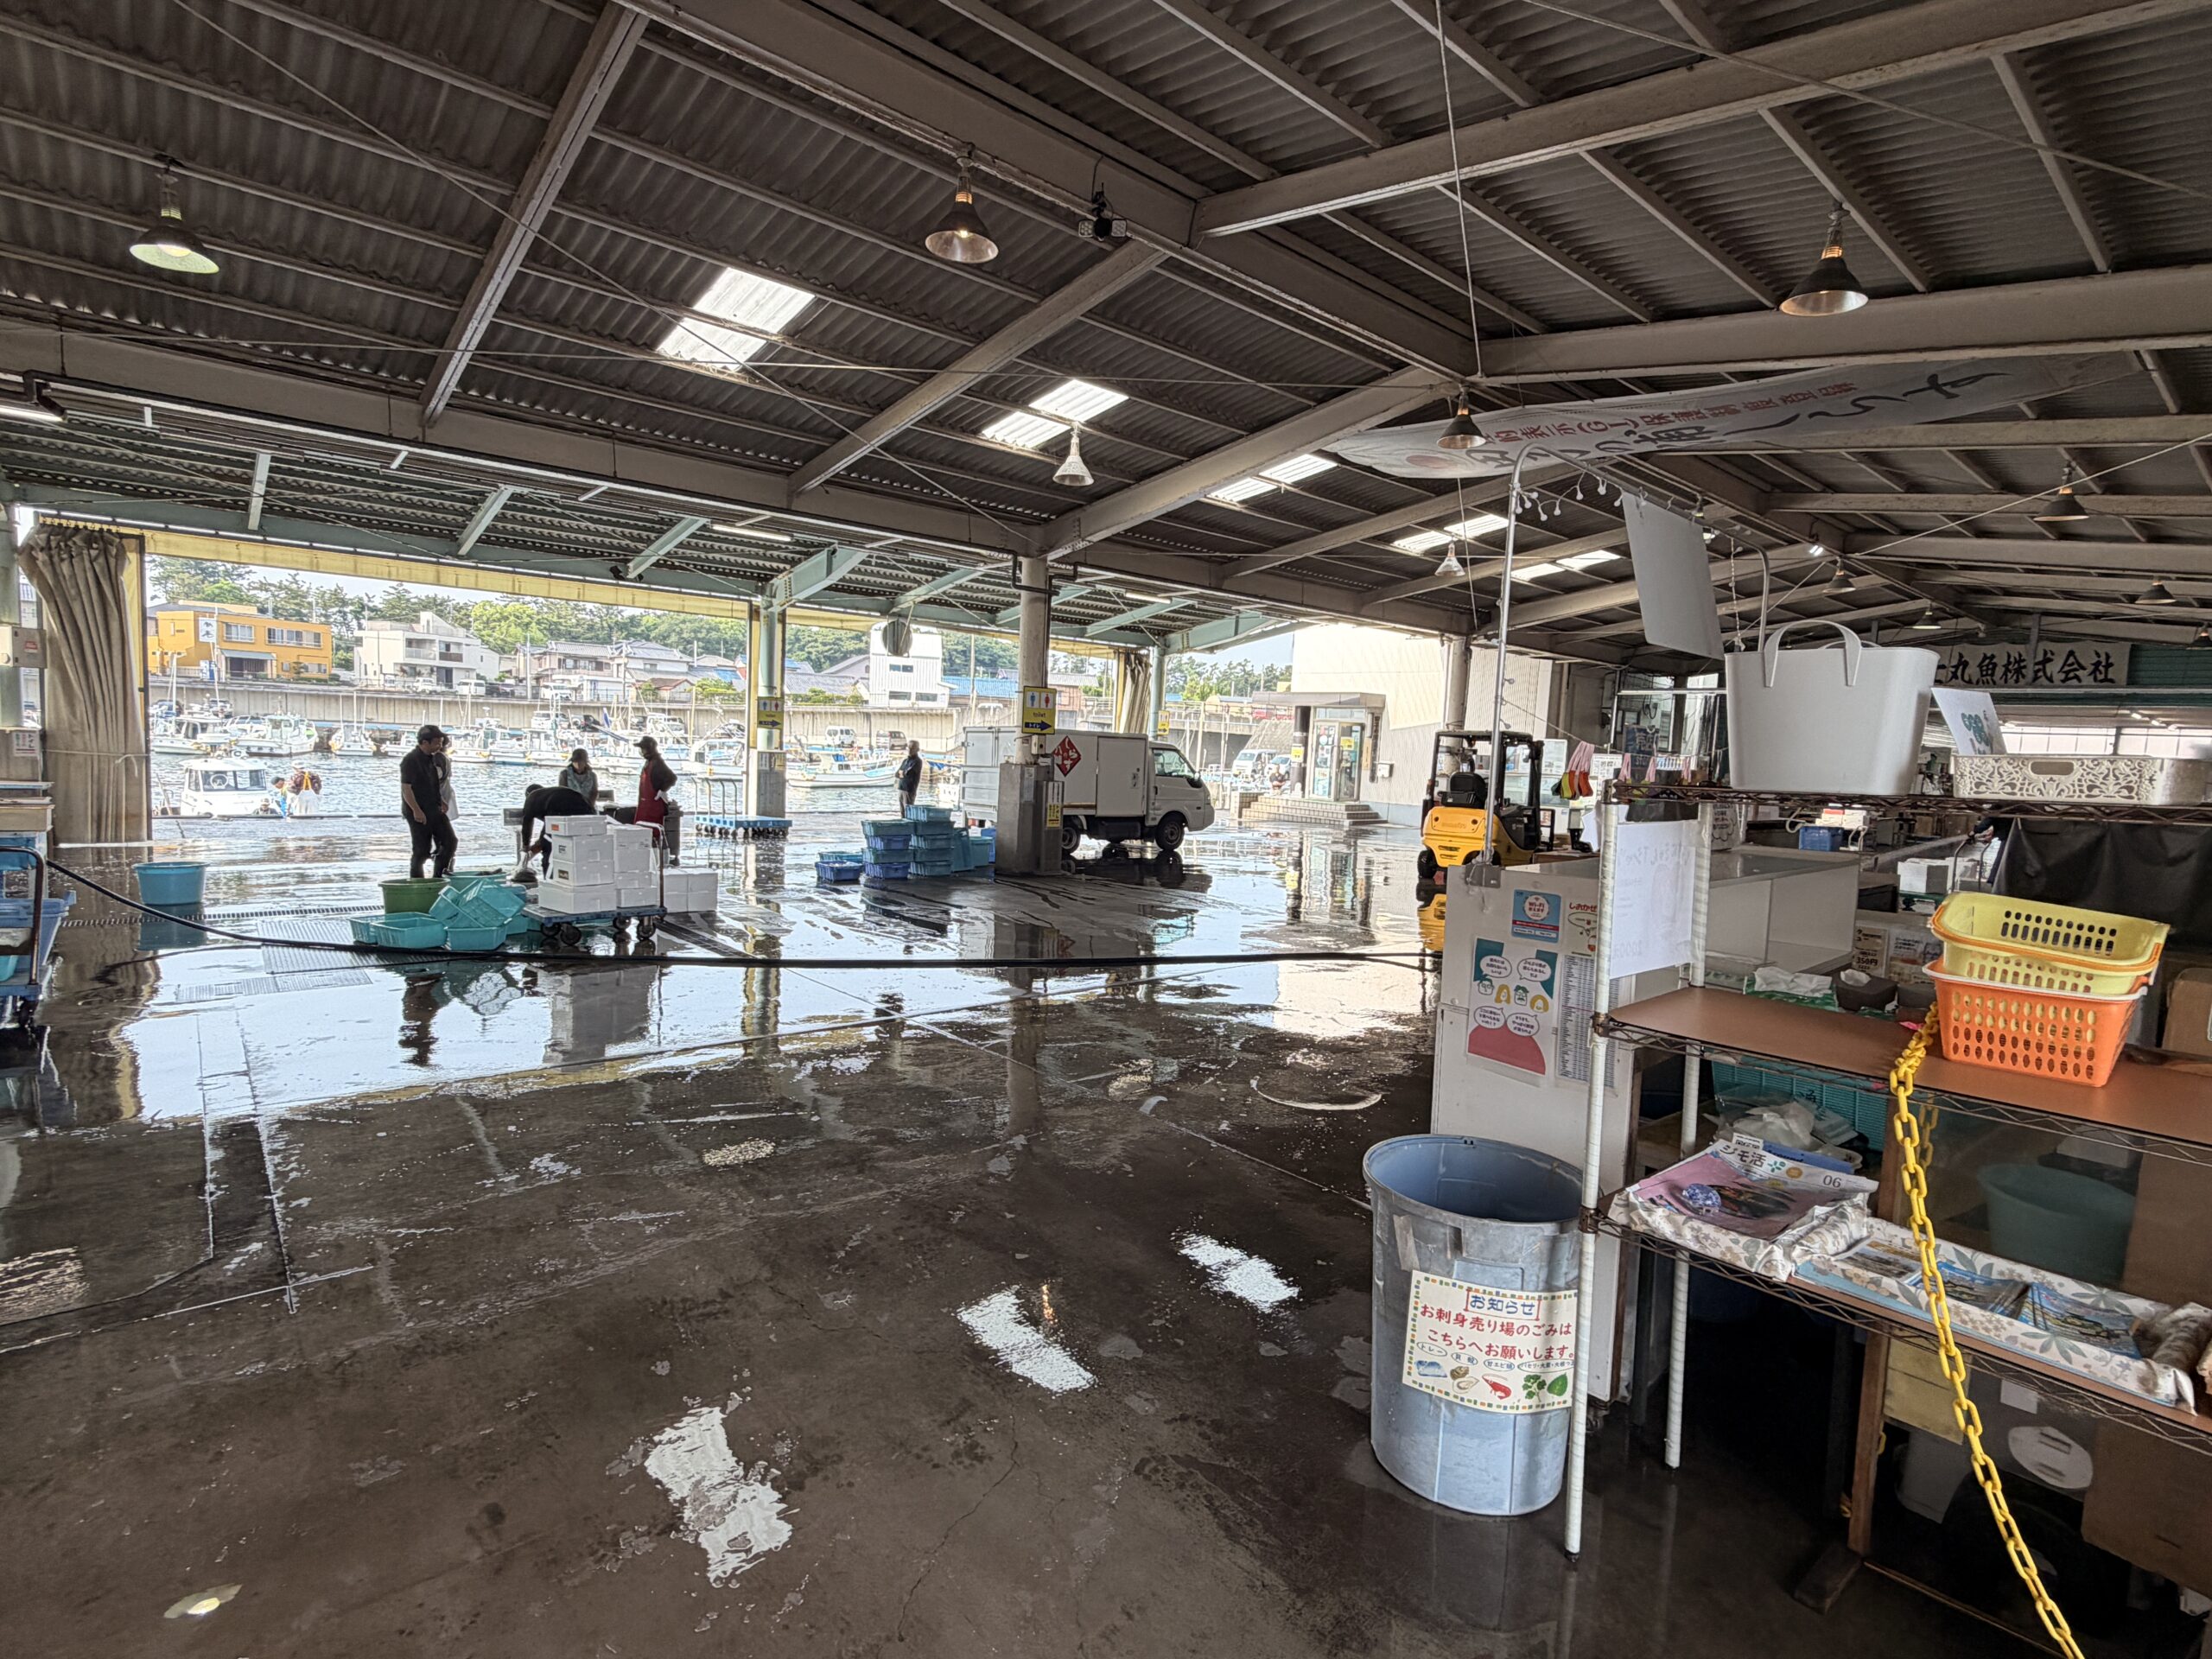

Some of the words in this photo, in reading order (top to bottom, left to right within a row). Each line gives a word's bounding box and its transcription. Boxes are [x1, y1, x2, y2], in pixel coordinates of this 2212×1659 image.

[1934, 649, 2117, 686] 丸魚株式会社
[1719, 1144, 1766, 1168] ジモ活
[1823, 1174, 1842, 1188] 06
[1470, 1294, 1536, 1316] お知らせ
[1420, 1304, 1573, 1338] お刺身売り場のごみは
[1421, 1344, 1443, 1355] トレー
[1427, 1328, 1575, 1361] こちらへお願いします。
